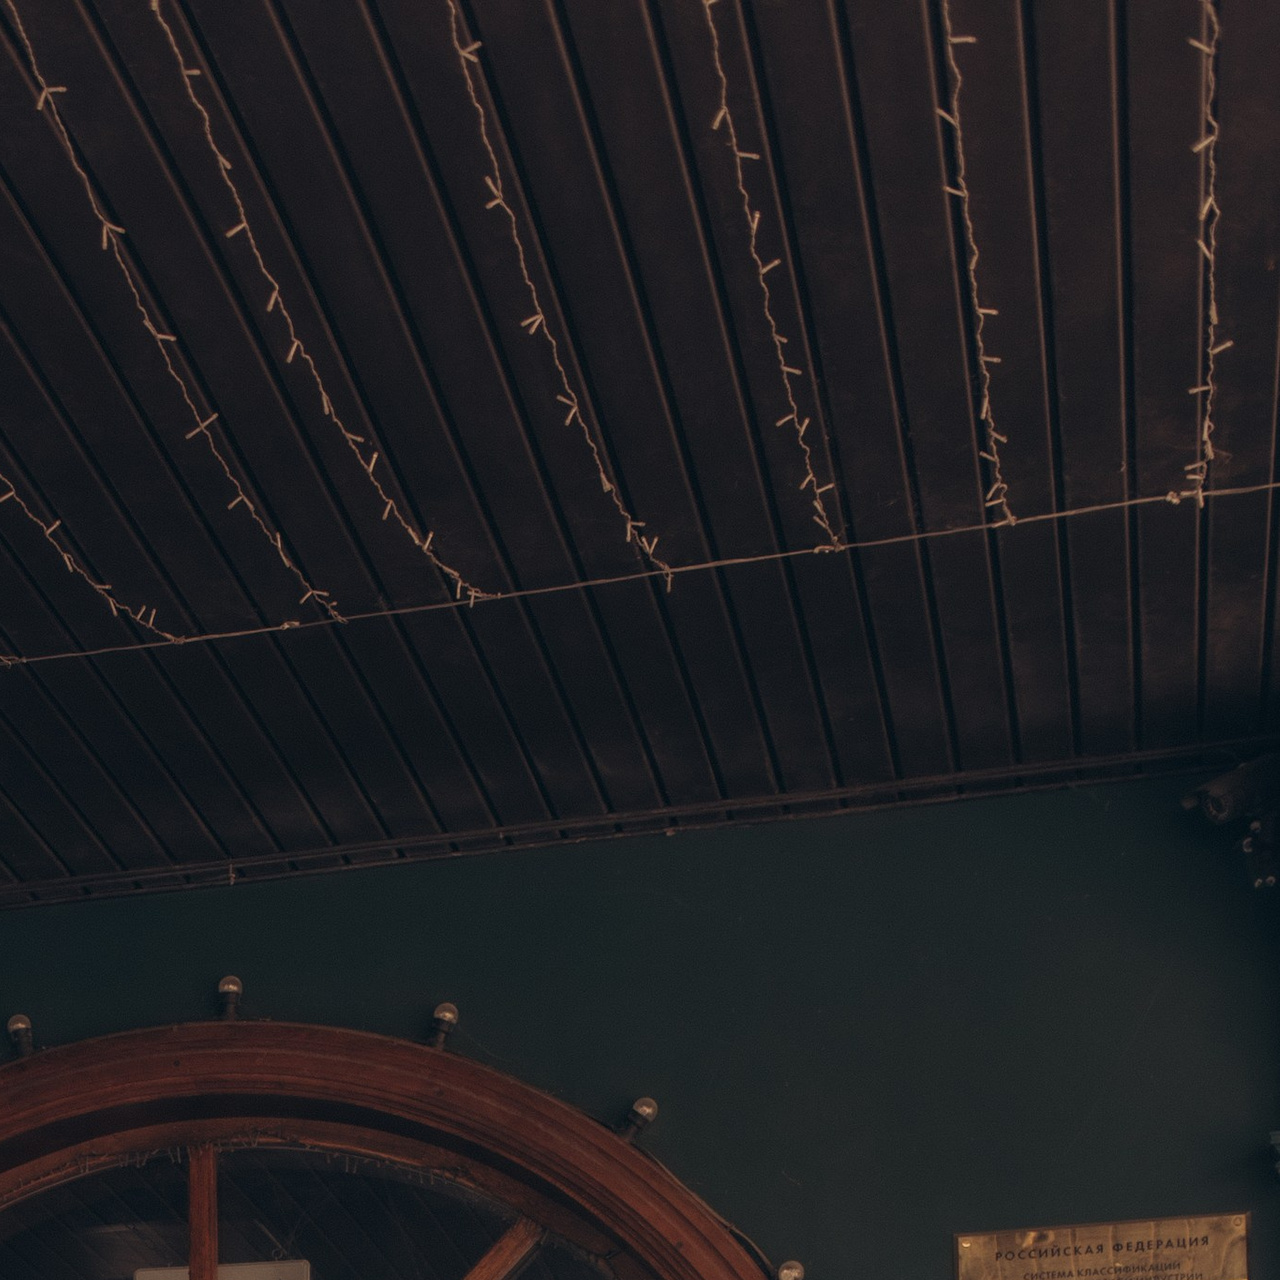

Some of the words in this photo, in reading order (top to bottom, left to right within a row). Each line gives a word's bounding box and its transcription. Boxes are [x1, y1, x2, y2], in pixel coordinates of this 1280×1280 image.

[995, 1243, 1104, 1261] РОССИЙСКАЯ
[1112, 1236, 1209, 1253] ФЕДЕРАЦИЯ
[1023, 1270, 1074, 1280] СИСТЕМА
[1077, 1262, 1181, 1278] КЛАССИФИКАЦИИ
